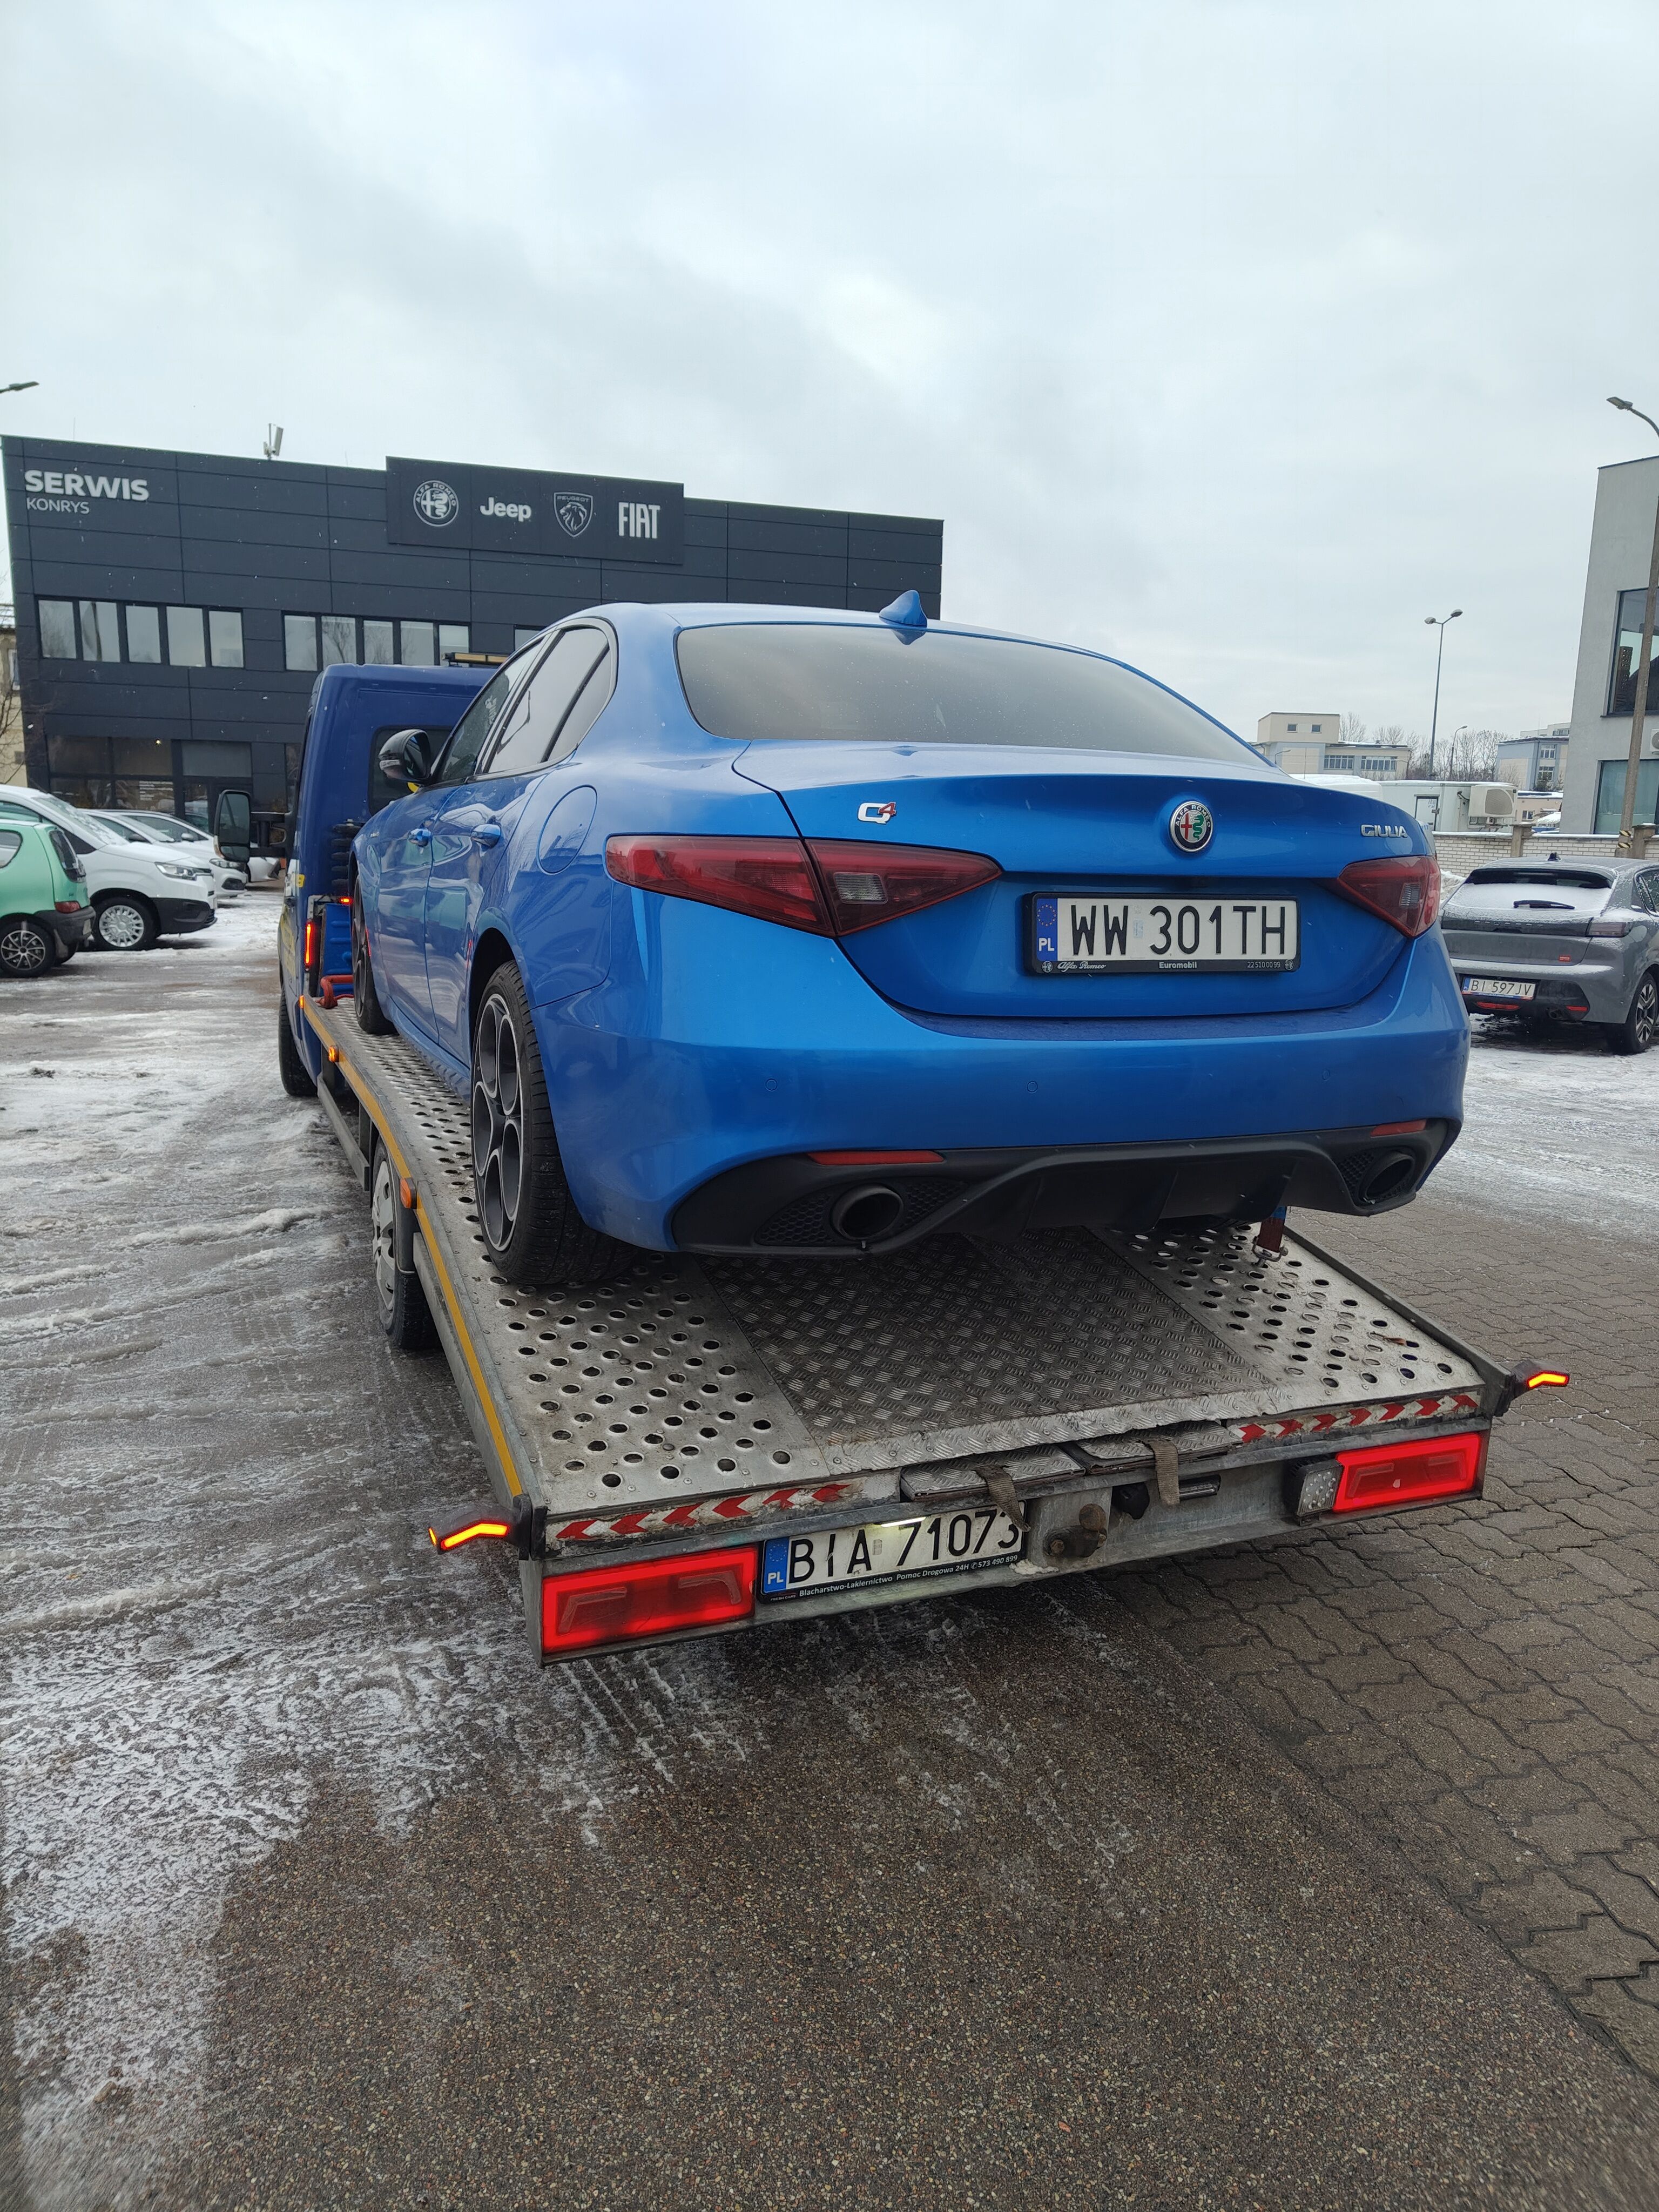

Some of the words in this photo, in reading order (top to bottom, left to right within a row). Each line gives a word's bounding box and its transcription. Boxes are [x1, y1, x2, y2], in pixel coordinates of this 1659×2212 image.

[24, 470, 150, 501] SERWIS
[416, 484, 430, 503] ALFA
[433, 483, 456, 506] ROMEO
[27, 497, 90, 514] KONRYS
[480, 497, 531, 522] Jeep
[618, 502, 660, 539] FIAT
[858, 802, 896, 824] Q4
[1175, 807, 1189, 826] ALFA
[1191, 805, 1211, 827] ROMEO
[1361, 824, 1408, 838] GIULIA
[1071, 905, 1129, 955] WW
[1150, 905, 1285, 955] 301TH
[1038, 938, 1055, 952] PL
[1057, 961, 1077, 972] Alfa
[1079, 961, 1107, 969] Romeo
[1471, 980, 1486, 992] BI
[1492, 982, 1532, 995] 597JV
[788, 1529, 872, 1584] BIA
[767, 1572, 784, 1584] PL
[799, 1576, 893, 1597] Blacharstwo-Lakiernictwo
[896, 1572, 921, 1581] Pomoc
[922, 1567, 954, 1576] Drogowa
[955, 1563, 969, 1572] 24H
